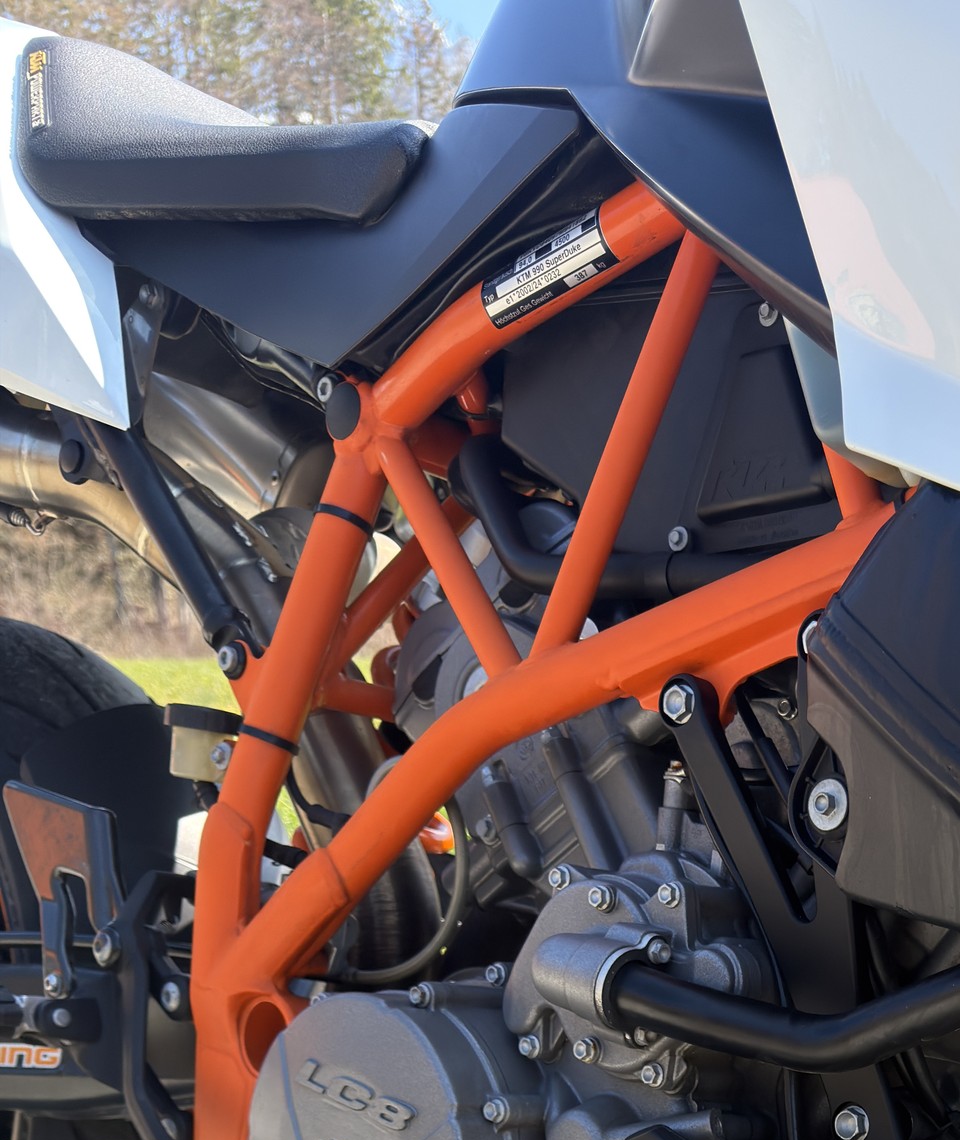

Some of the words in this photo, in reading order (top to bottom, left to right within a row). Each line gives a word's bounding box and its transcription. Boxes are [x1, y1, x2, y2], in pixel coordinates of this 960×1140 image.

[483, 293, 495, 303] Typ
[516, 270, 531, 285] KTM
[532, 264, 545, 277] 990
[546, 243, 581, 269] SuperDuke
[574, 269, 588, 282] 387
[297, 1058, 418, 1132] LC8
